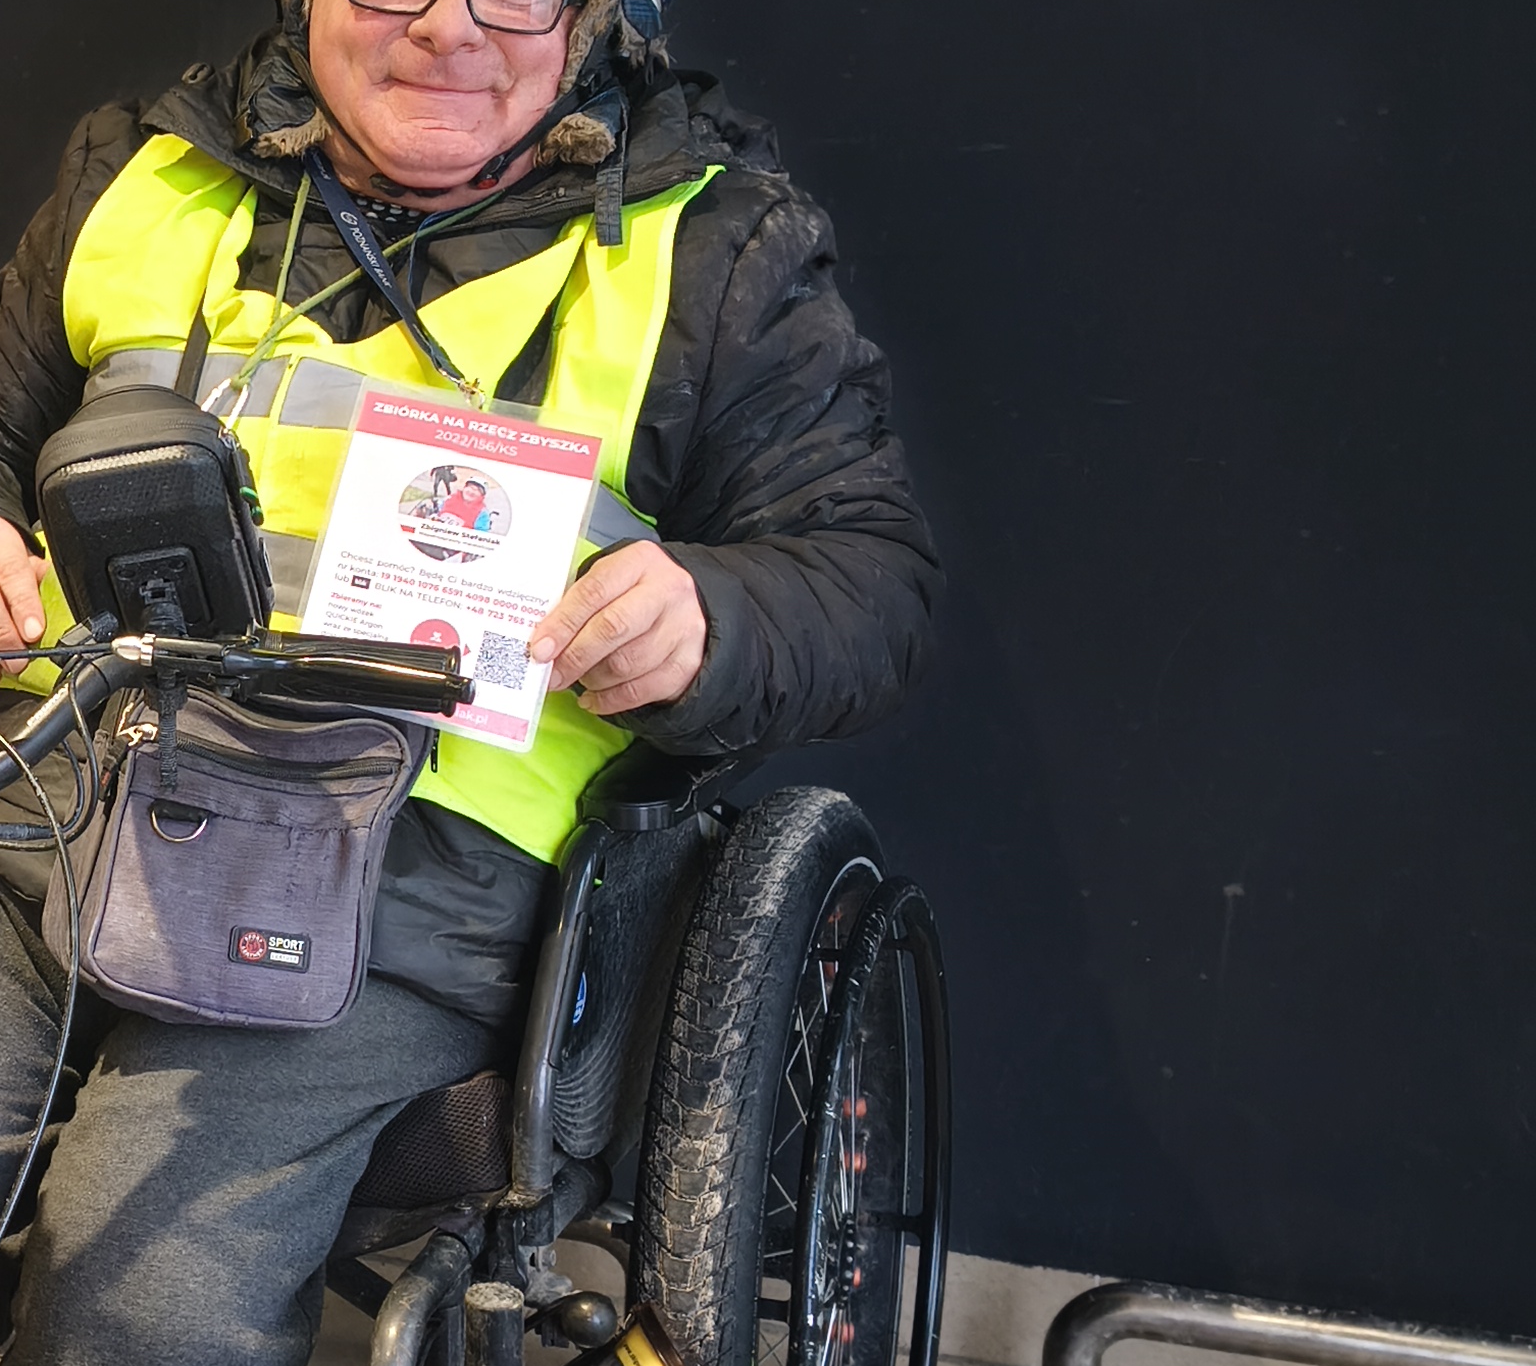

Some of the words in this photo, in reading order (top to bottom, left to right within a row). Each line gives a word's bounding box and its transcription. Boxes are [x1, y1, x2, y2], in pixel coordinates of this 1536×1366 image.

[373, 401, 440, 424] ZBIÓRKA
[442, 415, 465, 429] NA
[468, 420, 518, 441] RZECZ
[519, 432, 590, 455] ZBYSZKA
[434, 429, 518, 456] 2022/156/KS
[268, 936, 304, 951] SPORT
